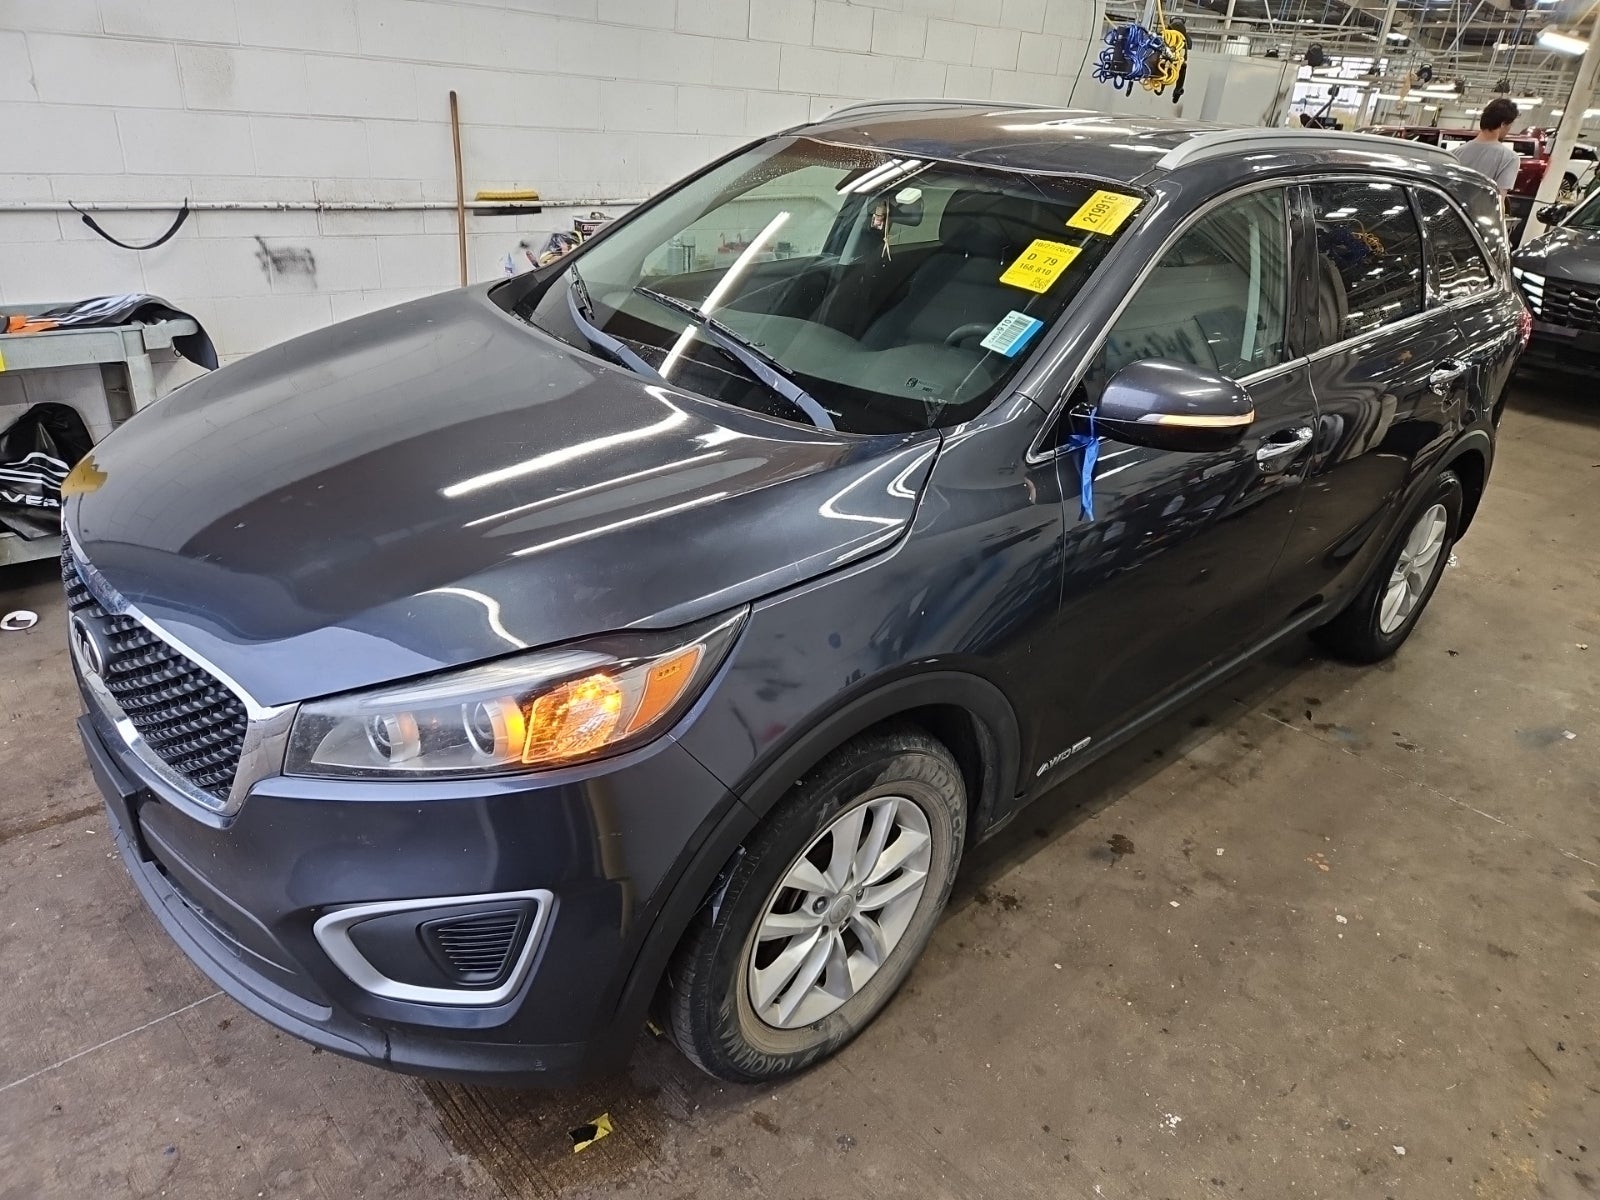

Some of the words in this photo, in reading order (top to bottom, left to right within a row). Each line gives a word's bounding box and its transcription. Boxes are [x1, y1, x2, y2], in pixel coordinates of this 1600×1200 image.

[1083, 195, 1118, 224] 219916
[1027, 252, 1038, 261] D
[1043, 256, 1058, 266] 79
[720, 1029, 794, 1074] YOKOHAMA
